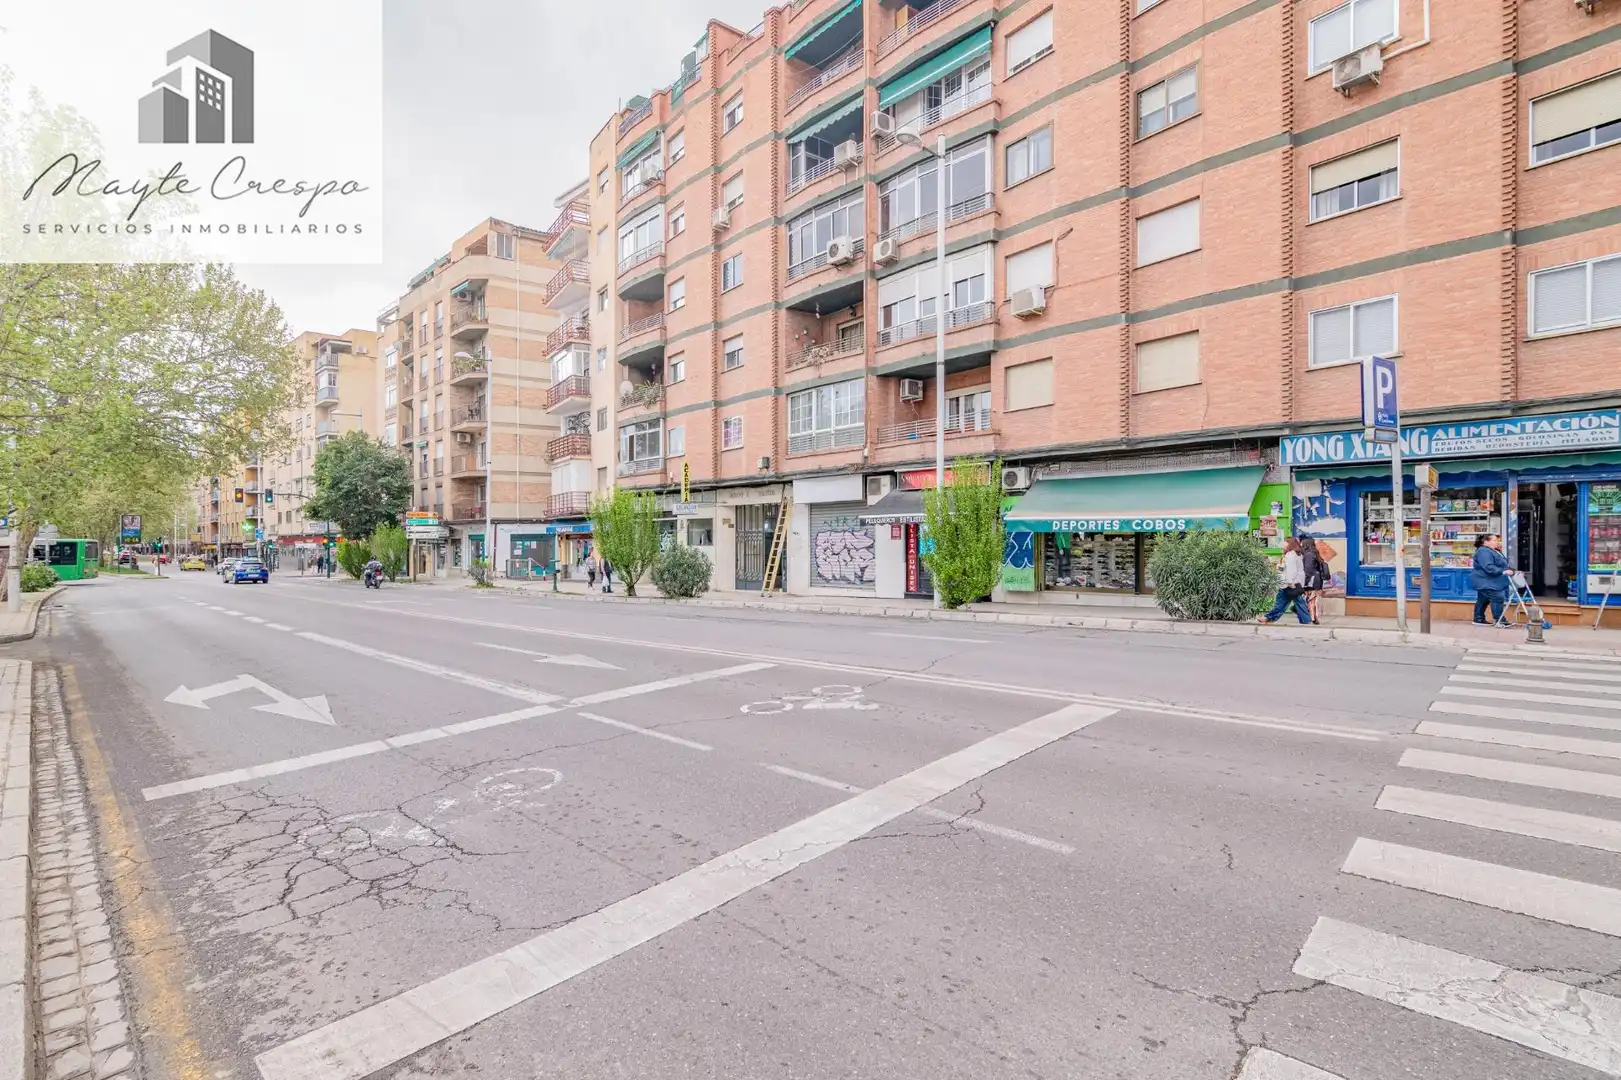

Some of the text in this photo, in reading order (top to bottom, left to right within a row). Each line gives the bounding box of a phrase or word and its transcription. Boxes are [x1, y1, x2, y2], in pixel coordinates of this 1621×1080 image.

[1376, 366, 1393, 409] P
[1432, 413, 1620, 440] ALIMENTACIÓN
[1283, 428, 1428, 463] YONG XIANG
[1518, 432, 1579, 441] GOLOSINAS
[1434, 445, 1476, 453] BEBIDAS
[1052, 519, 1186, 531] DEPORTES COBOS
